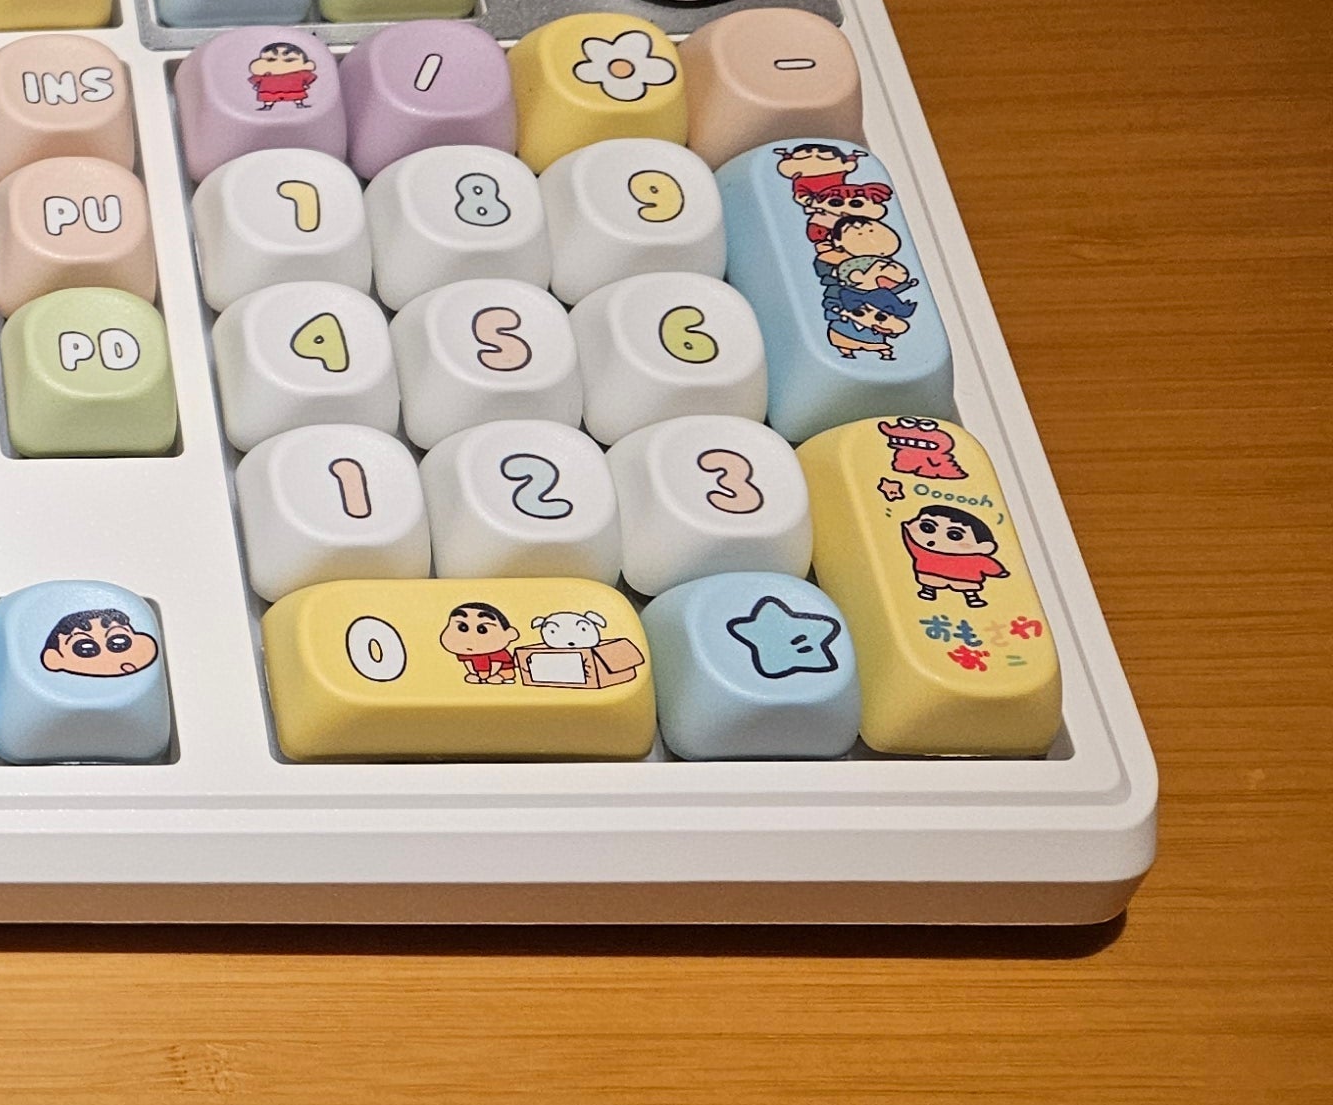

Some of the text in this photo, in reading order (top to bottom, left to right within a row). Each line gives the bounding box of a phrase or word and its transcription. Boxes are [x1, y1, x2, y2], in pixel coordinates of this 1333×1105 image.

[22, 65, 115, 106] INS
[43, 194, 123, 237] PU
[276, 180, 322, 233] 7
[454, 172, 512, 227] 8
[628, 170, 685, 223] 9
[58, 327, 141, 371] PD
[290, 312, 351, 372] 4
[471, 306, 533, 371] 5
[658, 305, 720, 364] 6
[329, 457, 372, 519] 1
[500, 452, 573, 520] 2
[696, 448, 764, 514] 3
[913, 483, 994, 509] Oooooh
[345, 615, 407, 682] 0
